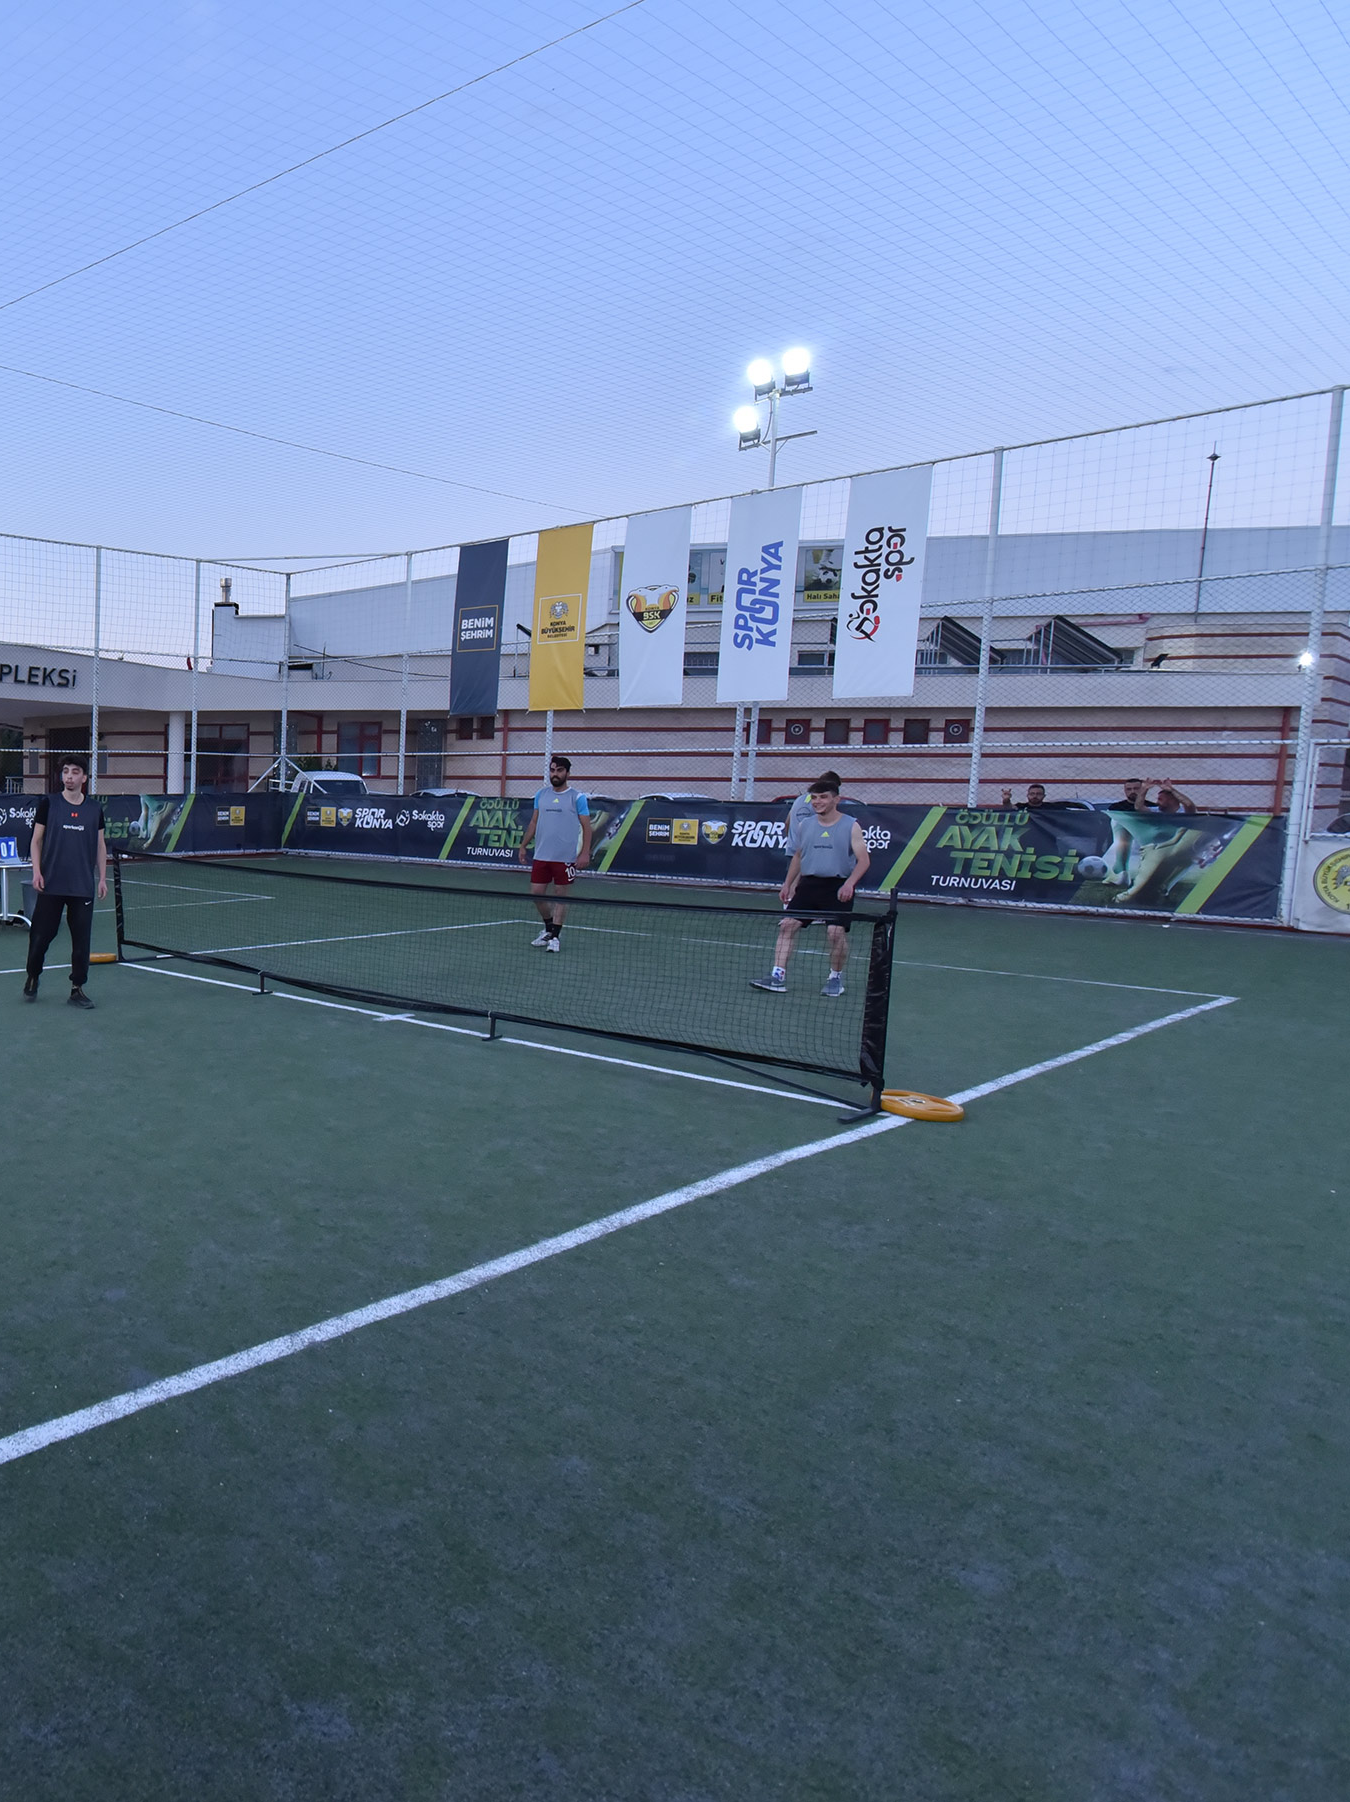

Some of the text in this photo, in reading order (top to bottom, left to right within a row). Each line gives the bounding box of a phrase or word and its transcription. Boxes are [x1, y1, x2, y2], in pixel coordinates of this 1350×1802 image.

[748, 540, 784, 648] KONYA
[642, 611, 661, 620] BSK
[732, 567, 758, 651] SPOR
[355, 807, 386, 819] SPOR
[412, 809, 445, 822] Sokakta
[469, 809, 521, 829] AYAK
[955, 809, 1031, 825] ÖDÜLLÜ
[355, 815, 393, 830] KONYA
[731, 820, 786, 835] SPOR
[731, 829, 789, 849] KONY
[935, 825, 1031, 852] AYAK
[466, 847, 514, 858] TURNUVASI
[950, 847, 1080, 881] TENİSİ
[930, 875, 1017, 891] TURNUVASI
